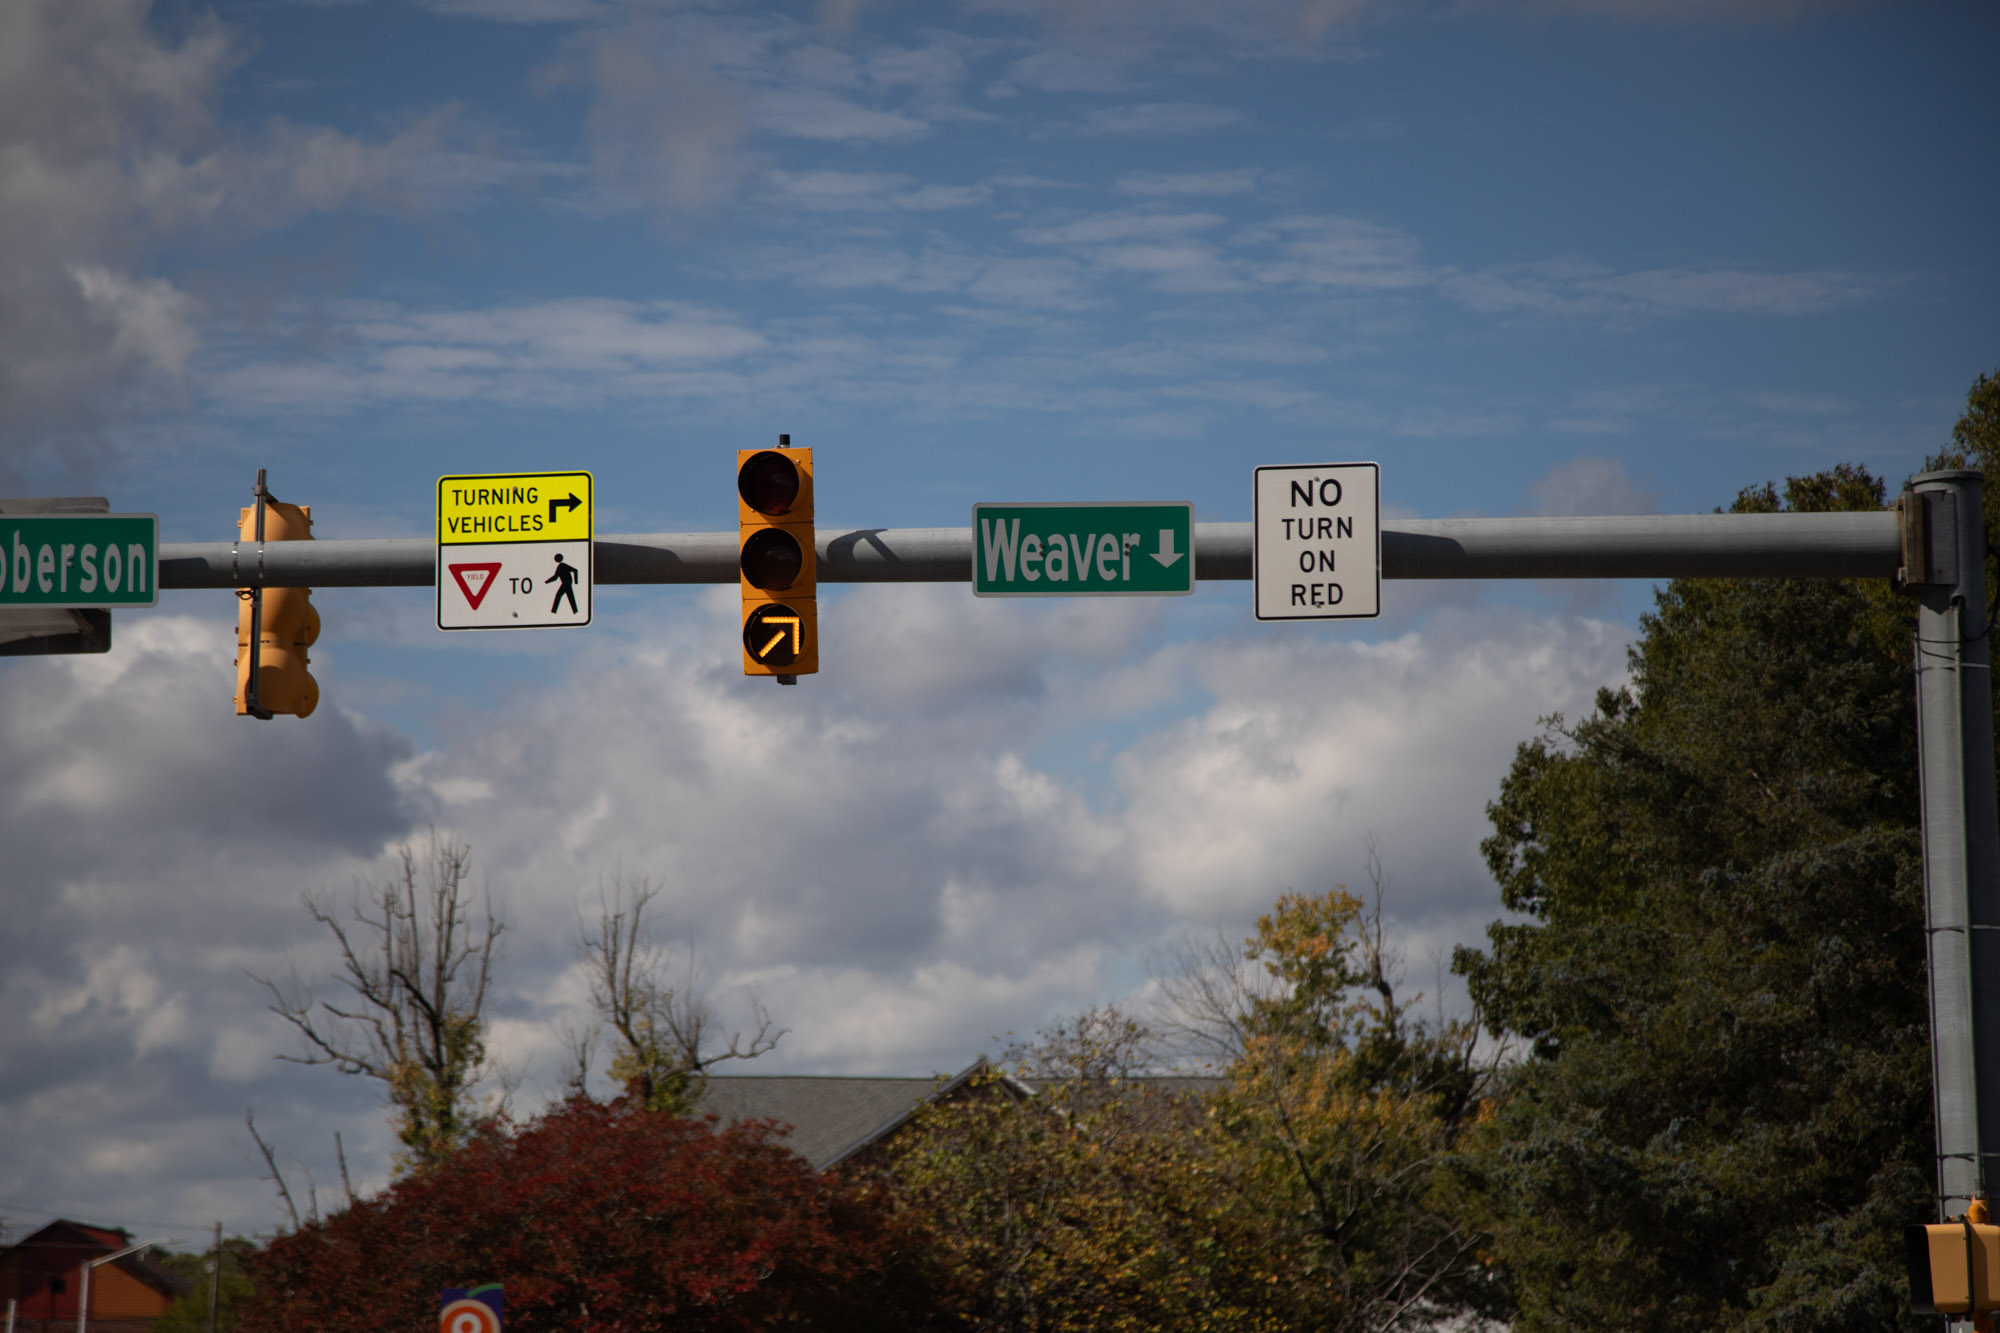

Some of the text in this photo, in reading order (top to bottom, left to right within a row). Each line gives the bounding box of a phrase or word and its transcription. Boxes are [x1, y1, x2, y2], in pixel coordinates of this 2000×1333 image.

[452, 486, 539, 507] TURNING
[1291, 478, 1343, 507] NO
[448, 514, 544, 534] VEHICLES
[1282, 516, 1353, 541] TURN
[981, 518, 1141, 582] Weaver
[1300, 550, 1335, 573] ON
[466, 573, 484, 581] YIELD
[509, 577, 534, 595] TO
[1291, 583, 1344, 607] RED
